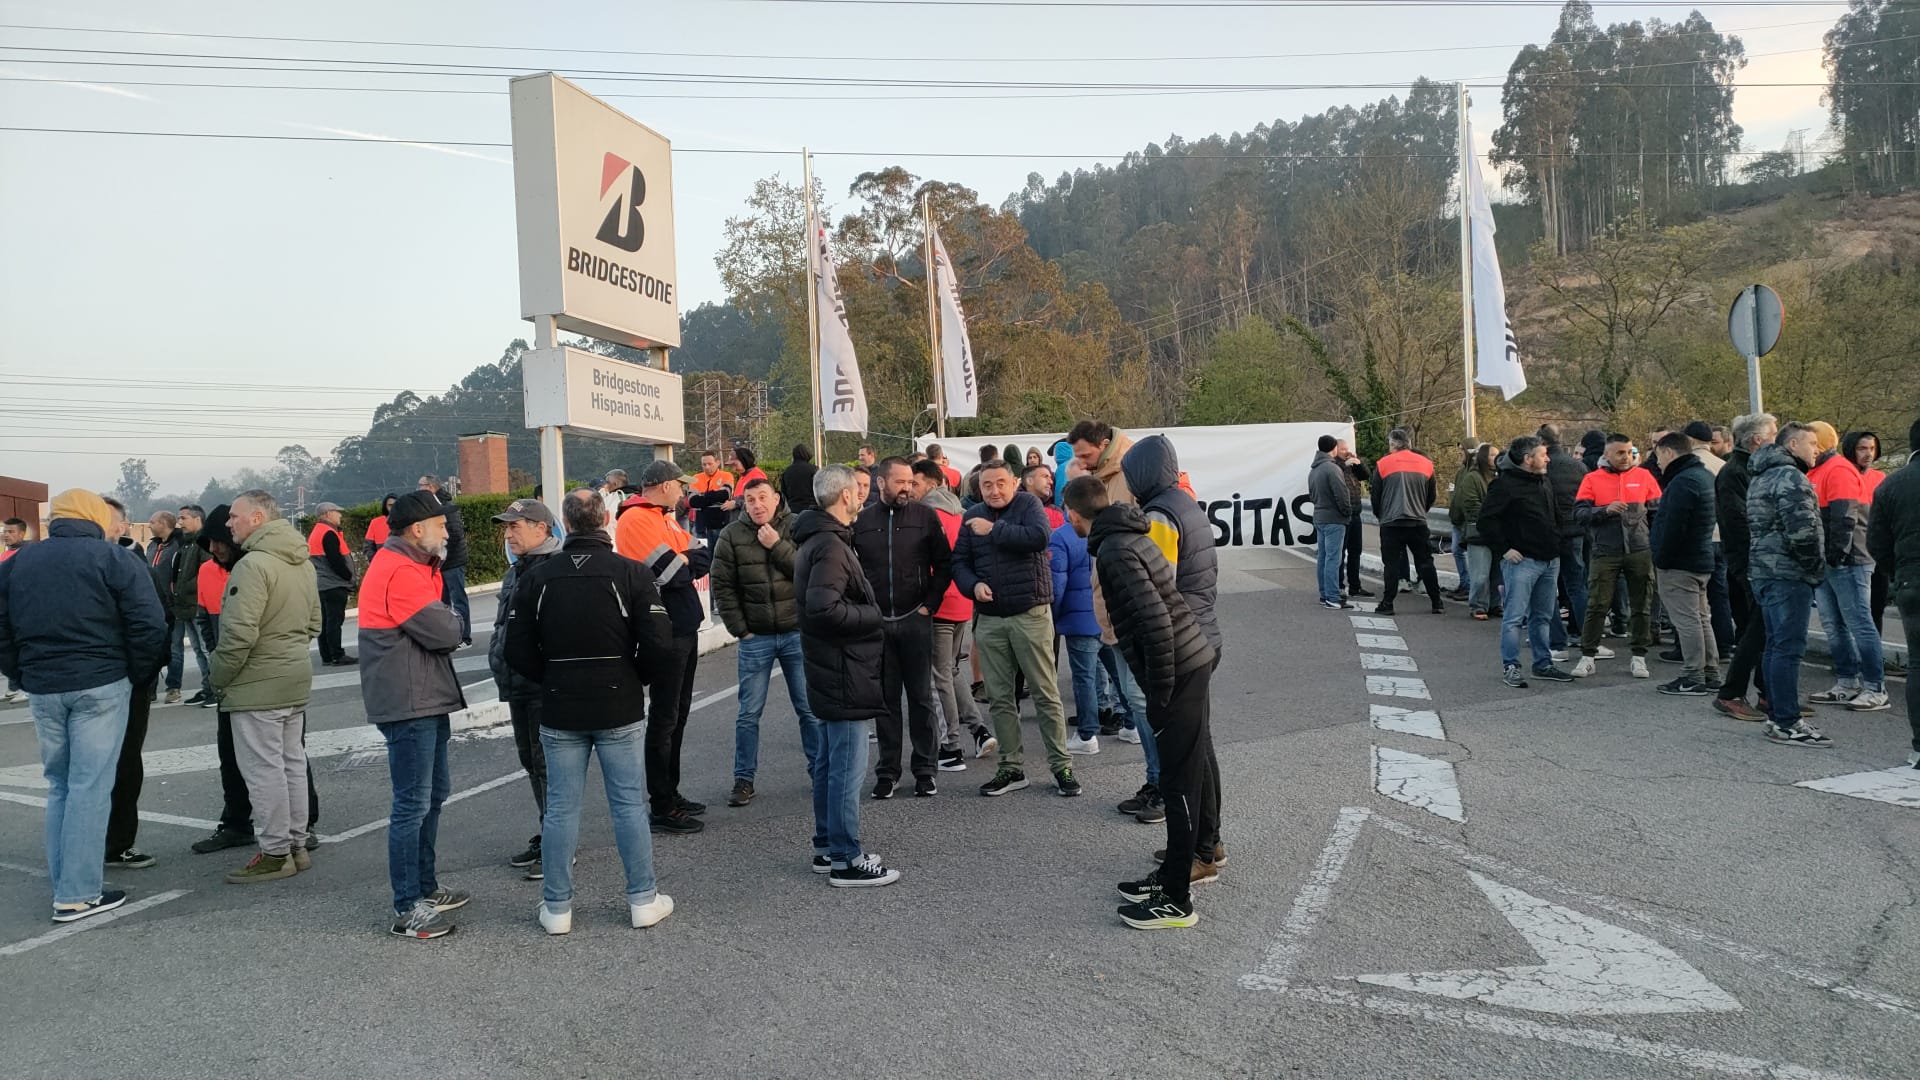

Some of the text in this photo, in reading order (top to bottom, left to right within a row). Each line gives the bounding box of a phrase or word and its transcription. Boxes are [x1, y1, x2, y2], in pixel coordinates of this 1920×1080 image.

[567, 246, 673, 304] BRIDGESTONE
[592, 368, 661, 399] Bridgestone
[591, 391, 665, 422] Hispania S.A.
